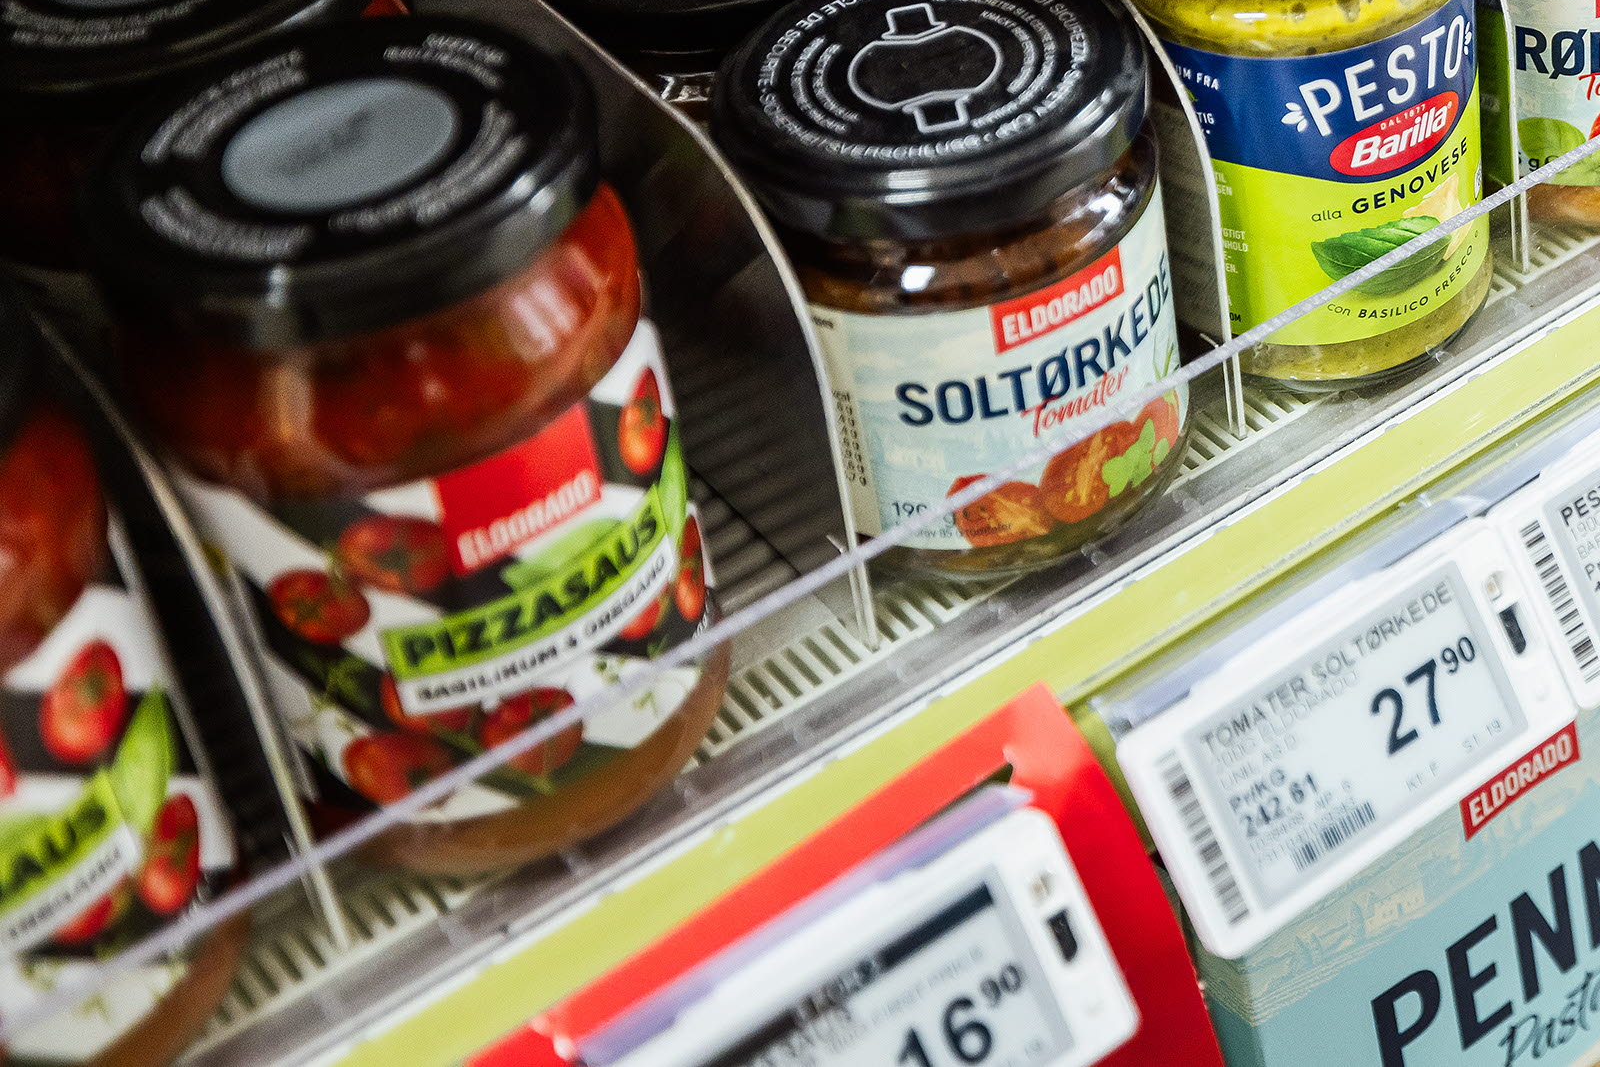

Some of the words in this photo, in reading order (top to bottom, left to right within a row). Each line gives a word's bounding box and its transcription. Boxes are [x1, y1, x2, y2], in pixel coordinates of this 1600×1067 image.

[795, 11, 824, 31] DE
[1196, 71, 1220, 91] FRA
[1298, 13, 1465, 137] PESTO
[1380, 114, 1402, 131] DAL
[1403, 103, 1427, 121] 1877
[1311, 208, 1343, 224] alla
[1351, 136, 1470, 215] GENOVESE
[1350, 106, 1448, 169] Barilla
[1001, 262, 1120, 345] ELDORADO
[1326, 301, 1351, 317] con
[1357, 295, 1430, 321] BASILICO
[1434, 244, 1473, 298] FRESCO
[895, 247, 1171, 427] SOLTØRKEDE
[1021, 364, 1129, 440] Tomater
[456, 468, 597, 570] ELDORADO
[402, 503, 660, 669] PIZZASAUS
[417, 643, 560, 703] BASILIKUM
[583, 554, 666, 636] OREGANO
[1202, 675, 1310, 754] TOMATER
[1311, 583, 1454, 683] SOLTØRKEDE
[1467, 733, 1573, 828] ELDORADO
